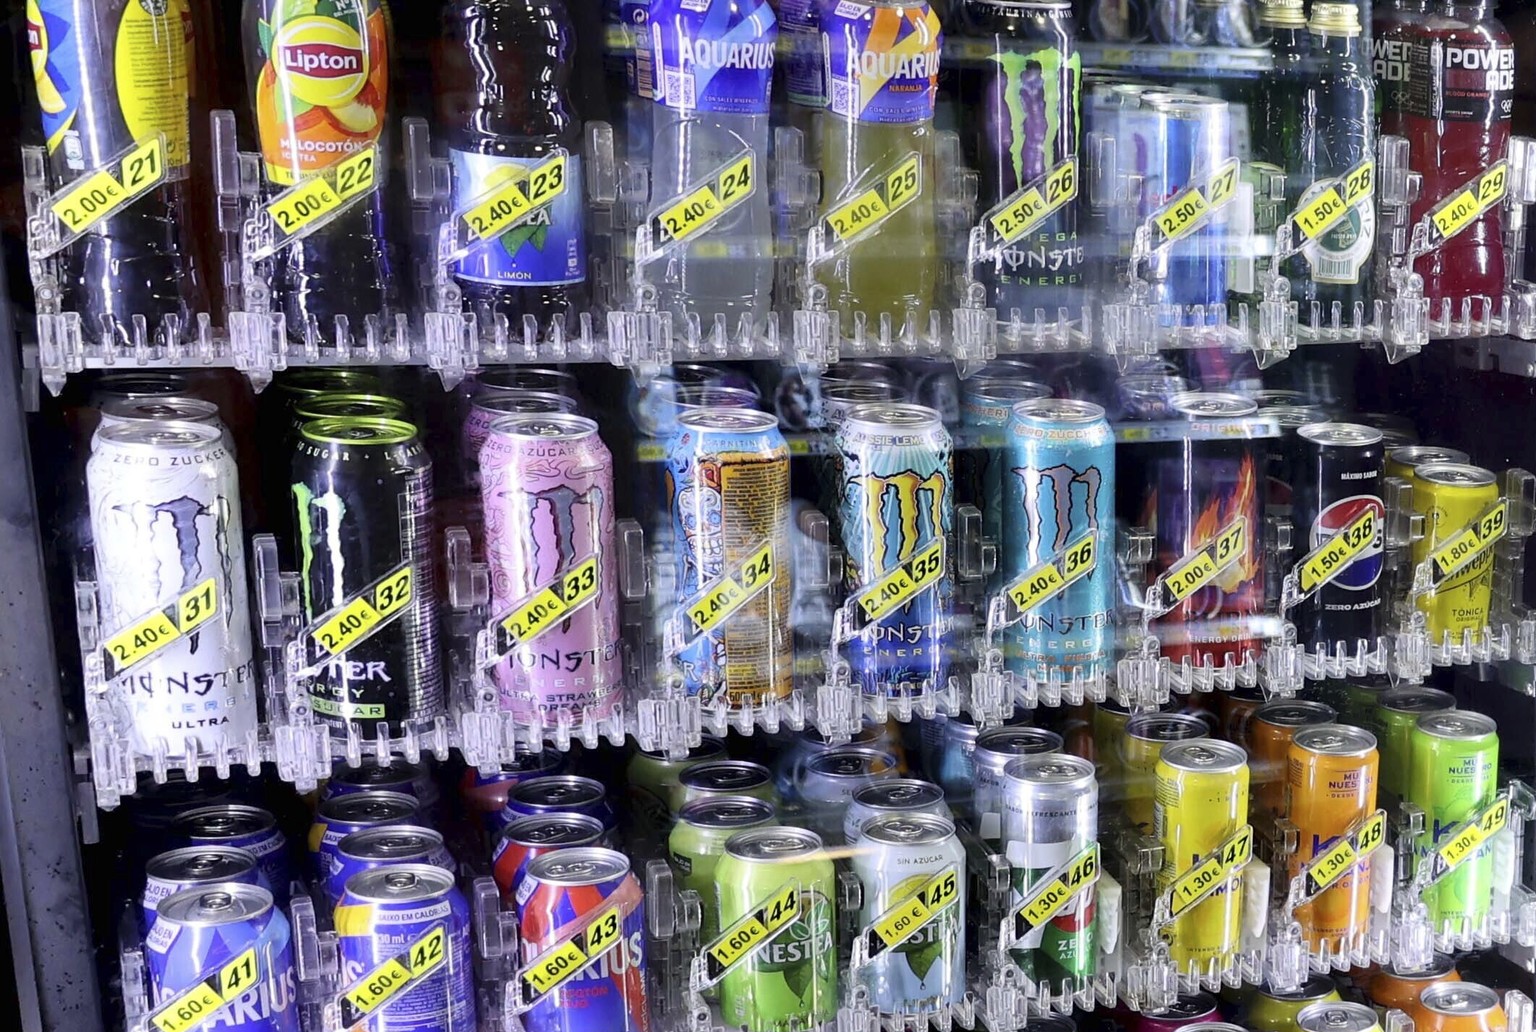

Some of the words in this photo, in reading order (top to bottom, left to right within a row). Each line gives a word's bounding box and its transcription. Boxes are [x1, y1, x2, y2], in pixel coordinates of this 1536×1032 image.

[284, 48, 358, 72] Lipton
[681, 37, 776, 70] AQUARIUS
[1446, 47, 1514, 70] POWER
[130, 155, 157, 186] 21
[340, 158, 372, 193] 22
[533, 166, 563, 199] 23
[722, 166, 749, 199] 24
[891, 167, 918, 198] 25
[1050, 169, 1073, 200] 26
[1348, 167, 1370, 199] 28
[1481, 172, 1504, 200] 29
[1211, 174, 1234, 203] 27
[1351, 517, 1373, 548] 38
[1482, 510, 1504, 540] 39
[1067, 543, 1092, 573] 36
[1219, 529, 1242, 558] 37
[745, 556, 769, 588] 34
[913, 551, 940, 582] 35
[380, 577, 409, 611] 32
[567, 567, 594, 601] 33
[185, 591, 211, 622] 31
[171, 715, 230, 729] ULTRA
[1484, 807, 1504, 832] 49
[1359, 822, 1381, 849] 48
[1225, 839, 1248, 865] 47
[1071, 856, 1094, 887] 46
[931, 876, 955, 907] 45
[770, 892, 795, 924] 44
[590, 916, 617, 947] 43
[413, 936, 442, 968] 42
[752, 931, 833, 964] NESTEA
[227, 961, 251, 990] 41
